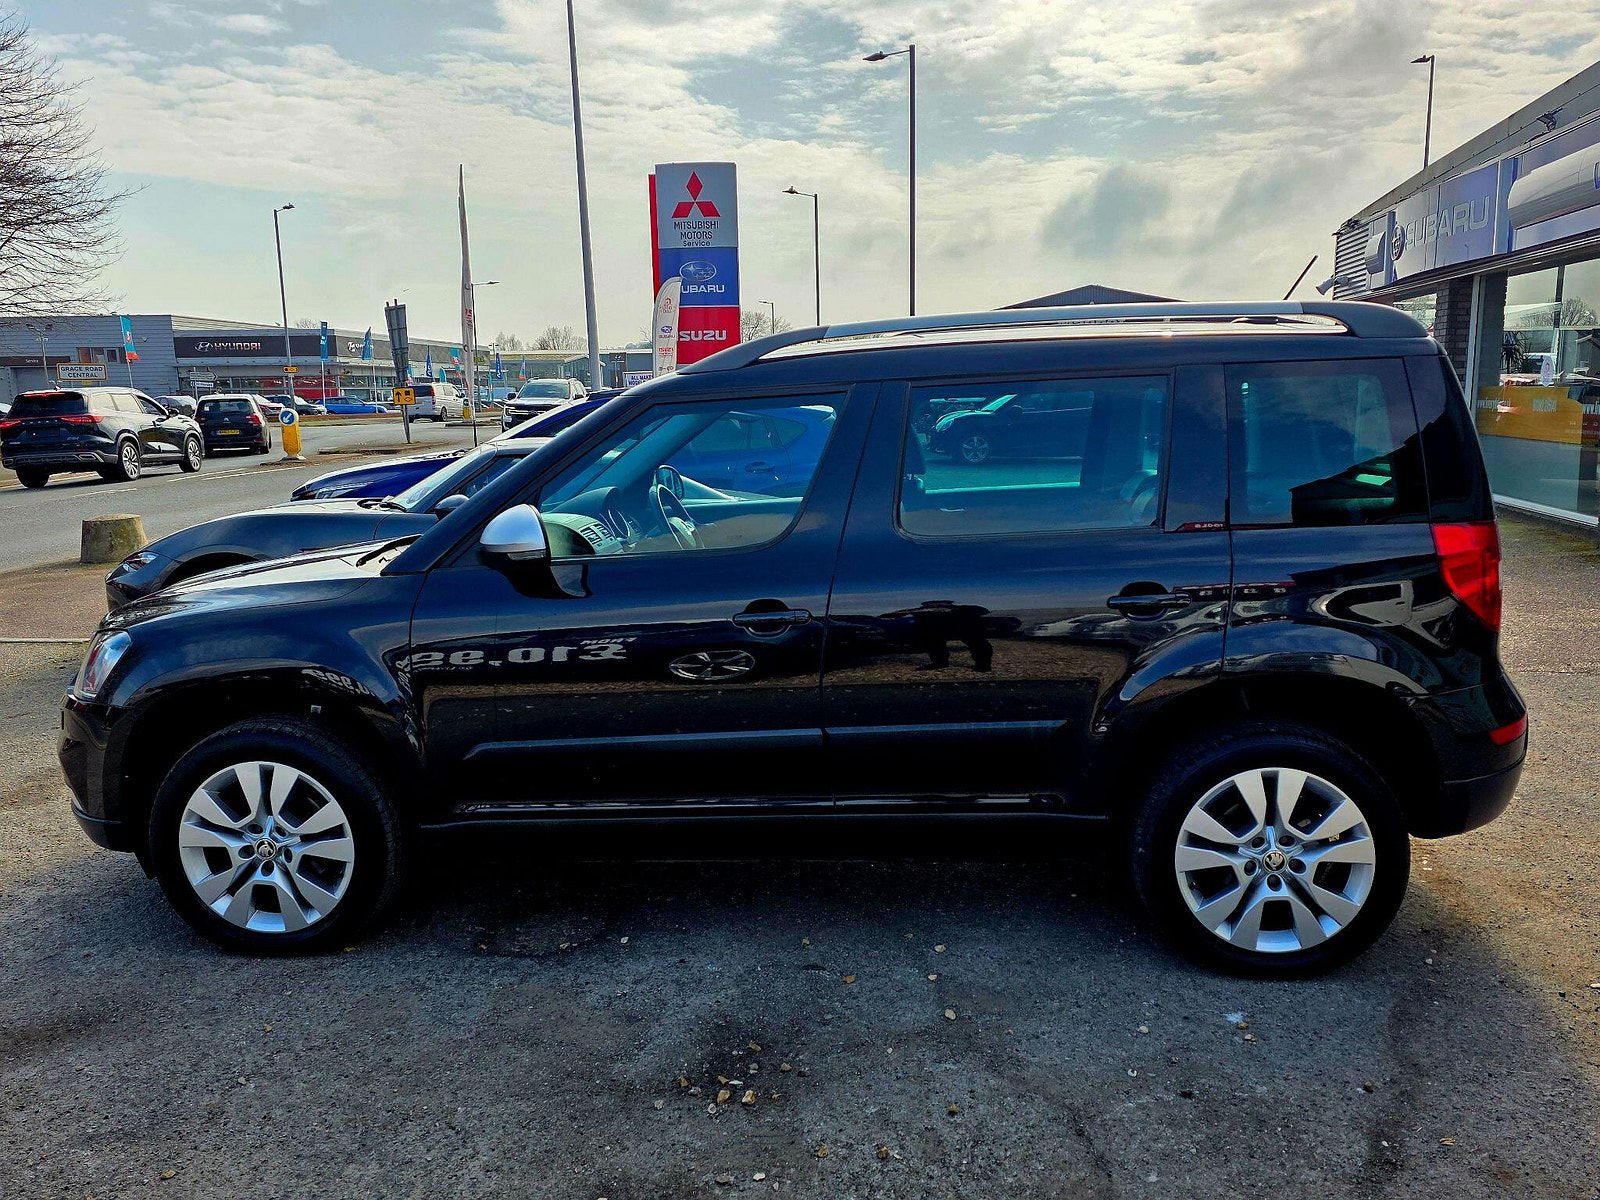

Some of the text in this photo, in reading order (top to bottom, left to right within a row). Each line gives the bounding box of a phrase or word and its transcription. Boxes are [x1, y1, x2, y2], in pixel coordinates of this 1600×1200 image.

[674, 220, 720, 230] MITSUBISHI
[1404, 195, 1490, 252] SUBARU
[680, 230, 714, 241] MOTORS
[682, 240, 712, 248] Service
[681, 284, 726, 294] UBARU
[677, 329, 727, 343] SUZU
[214, 341, 262, 352] HYUNDAI
